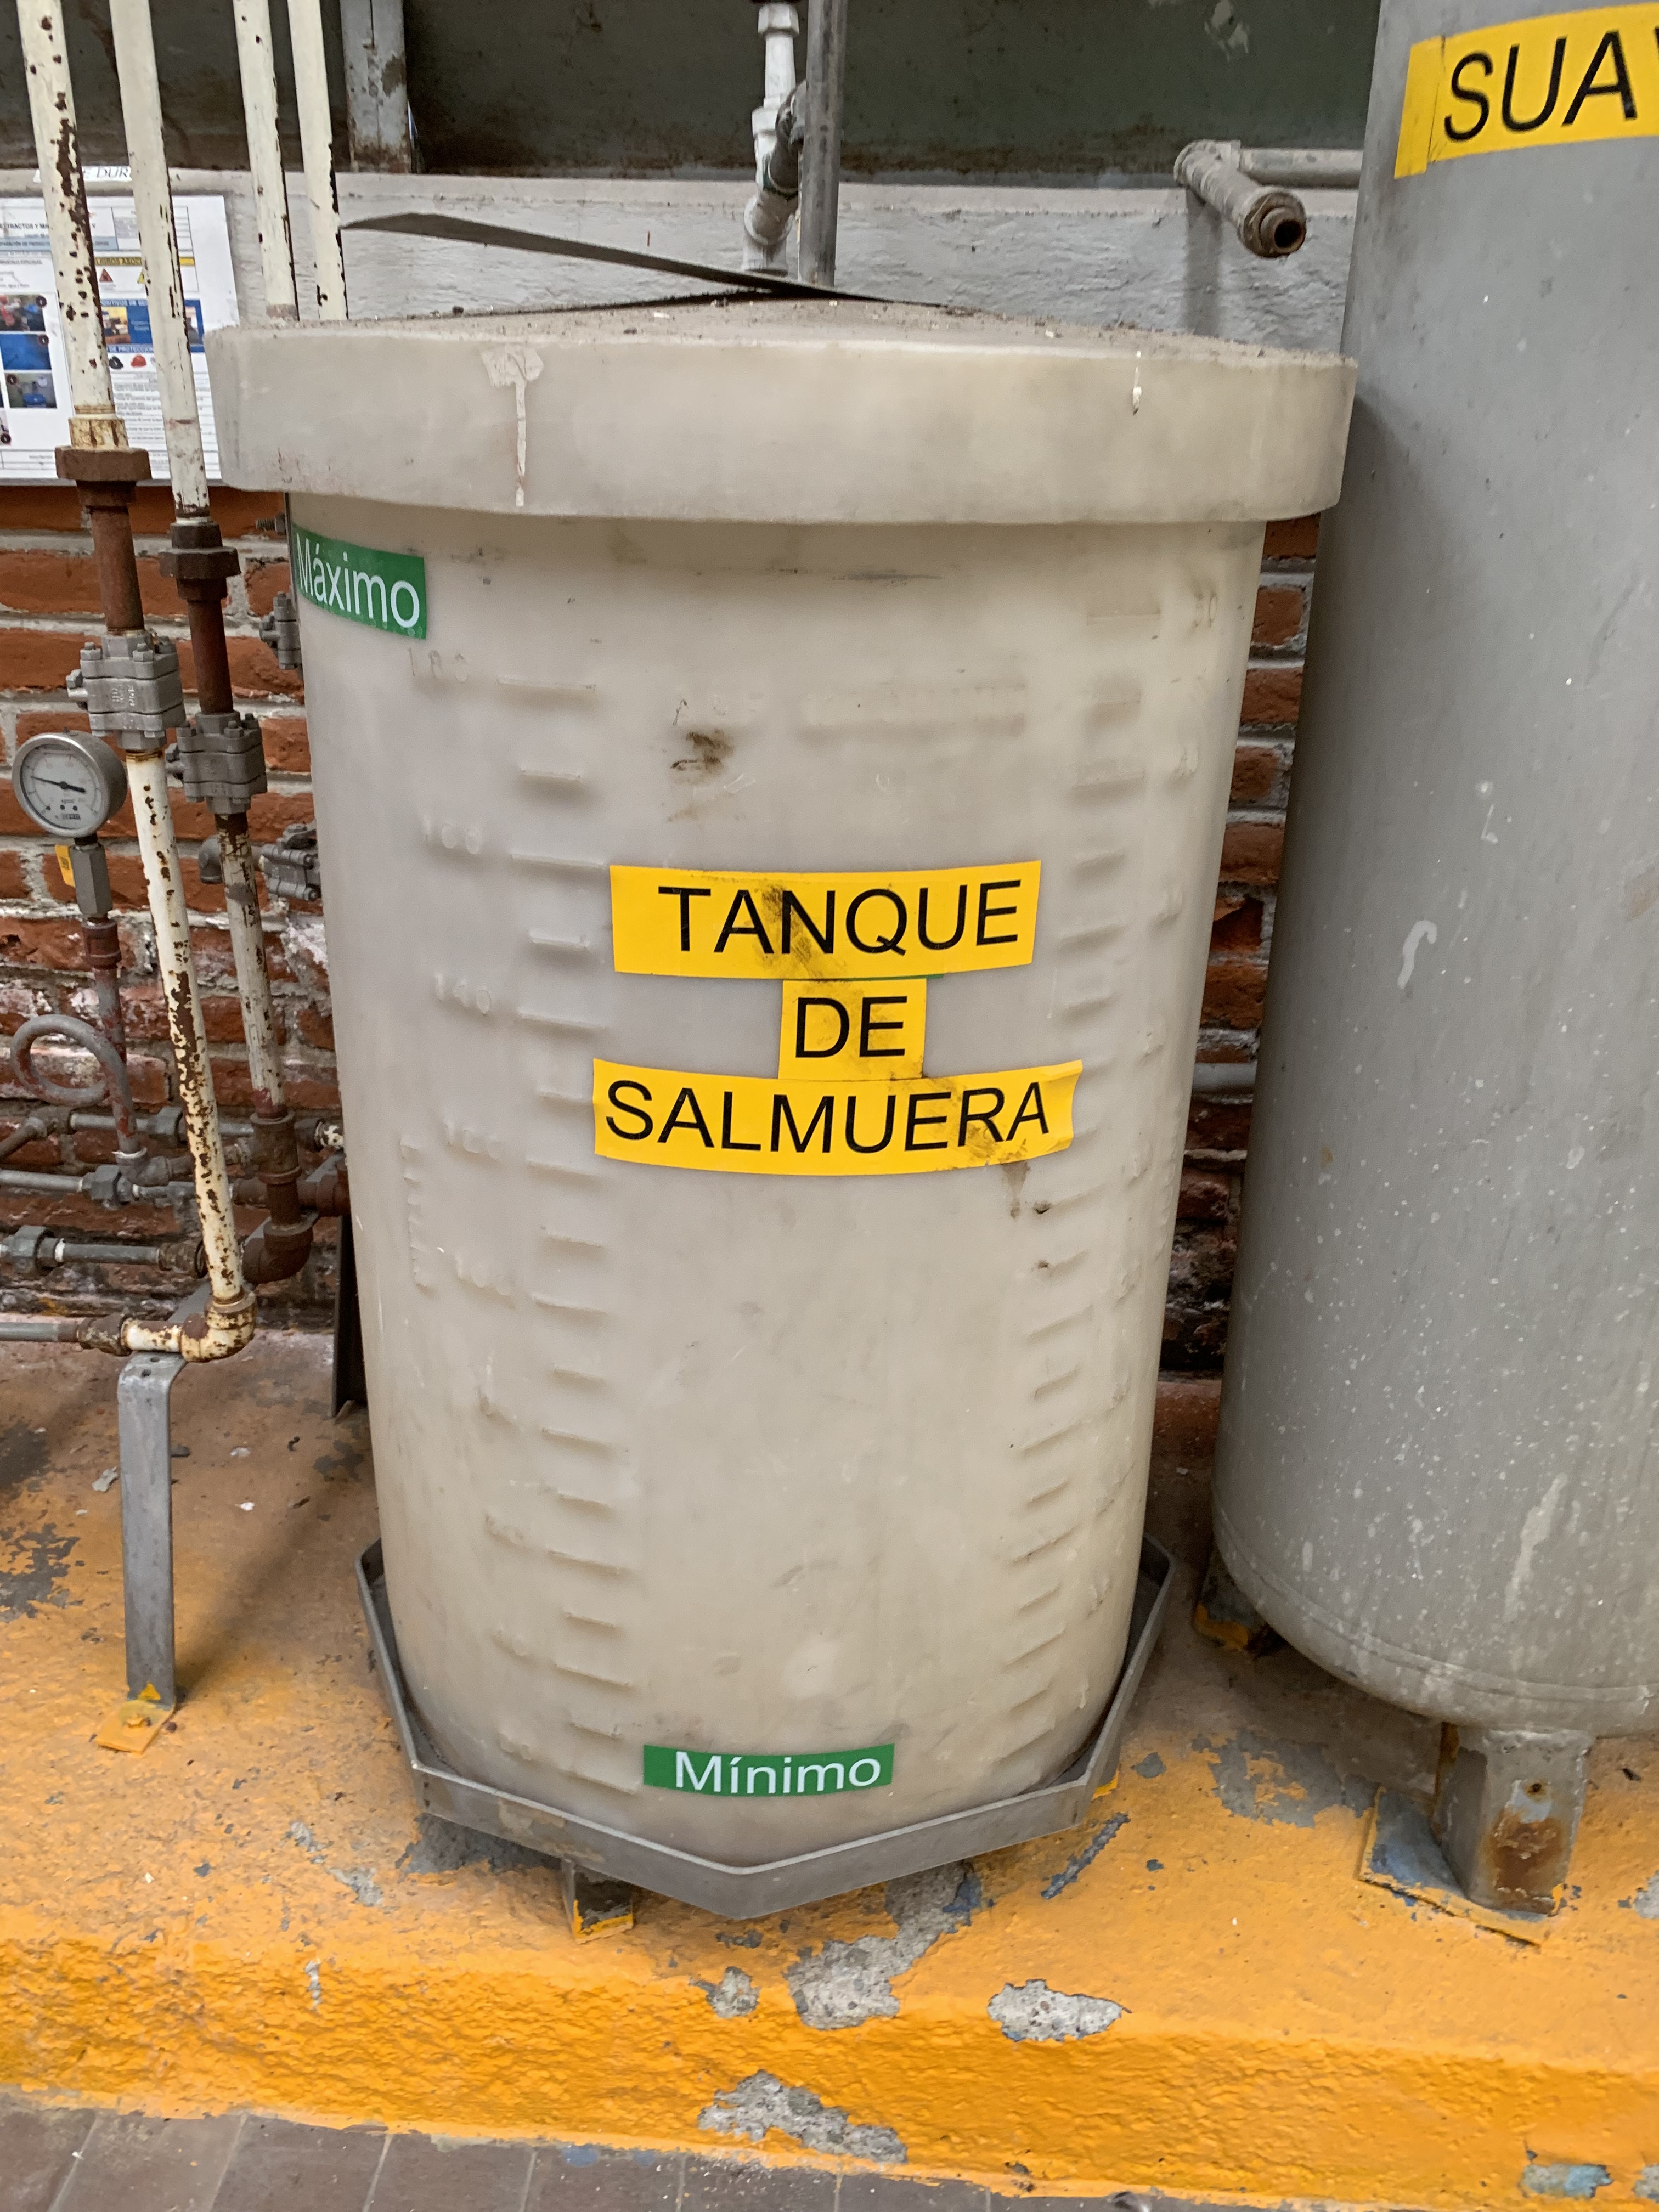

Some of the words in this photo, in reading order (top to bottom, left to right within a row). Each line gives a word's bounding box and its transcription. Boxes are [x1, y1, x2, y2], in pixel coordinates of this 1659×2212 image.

[1444, 26, 1659, 143] SUA
[296, 533, 420, 628] Máximo
[659, 879, 1022, 956] TANQUE
[795, 996, 908, 1059] DE
[606, 1080, 1050, 1154] SALMUERA
[675, 1751, 881, 1794] Mínimo
